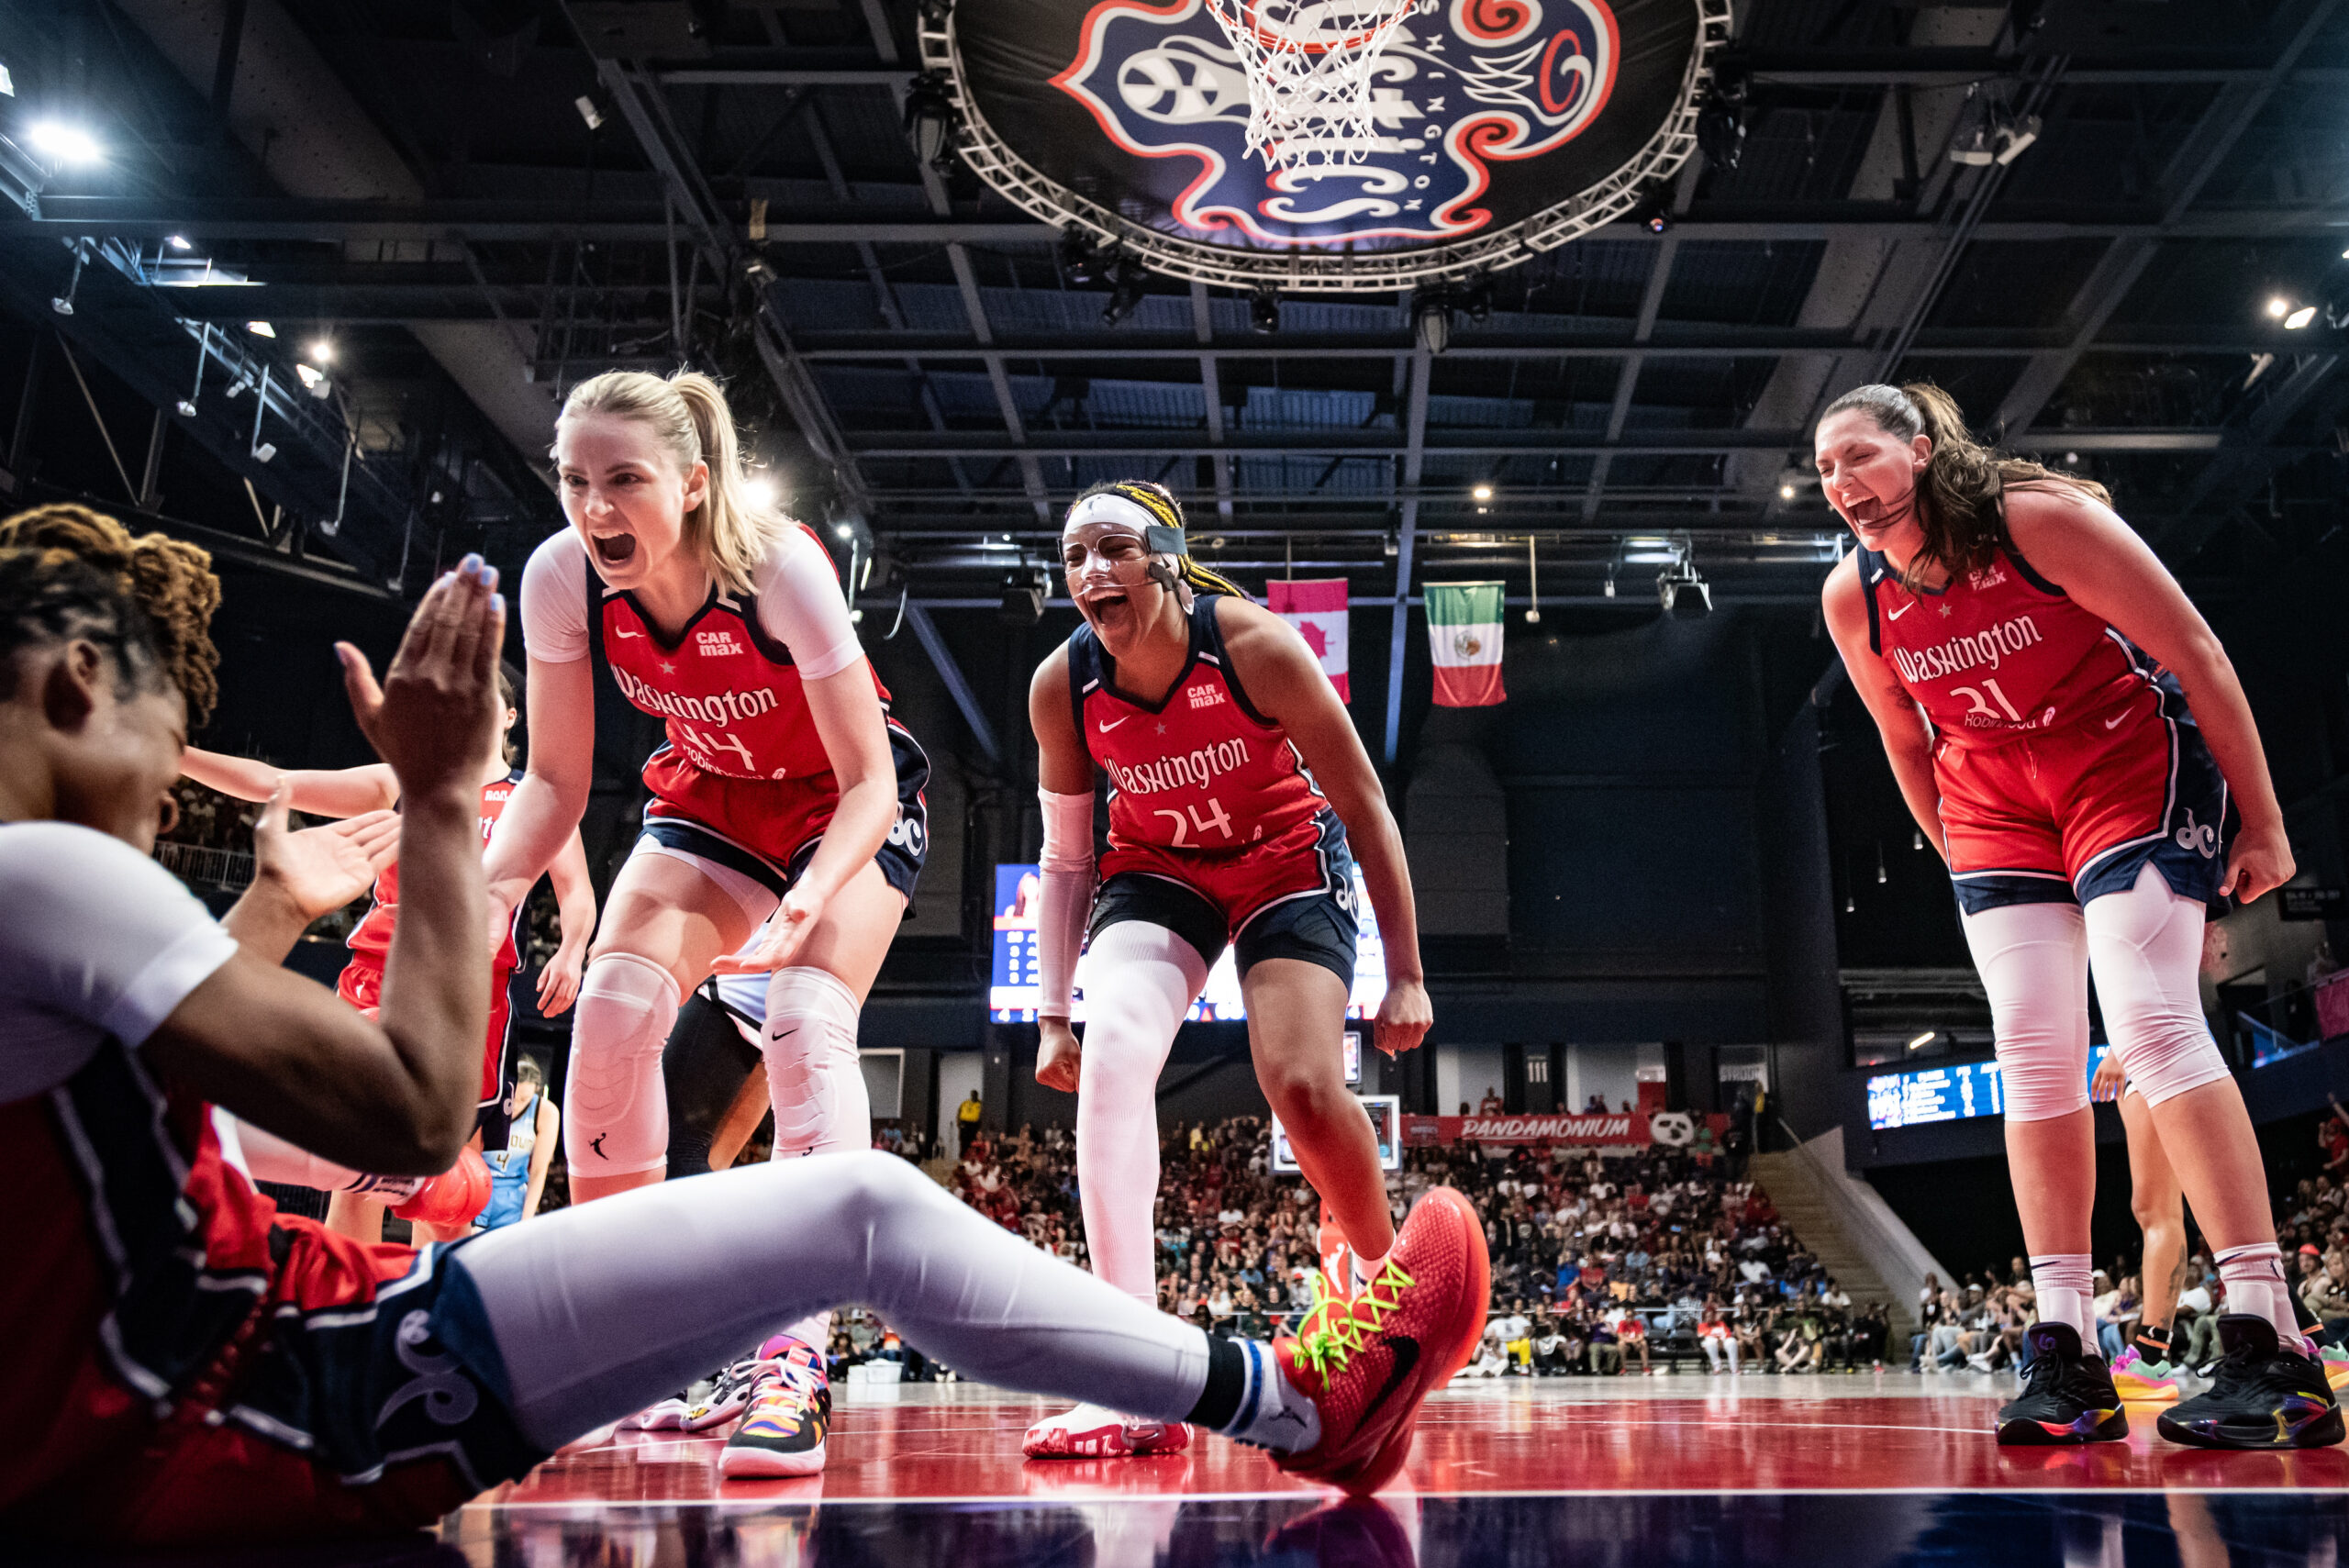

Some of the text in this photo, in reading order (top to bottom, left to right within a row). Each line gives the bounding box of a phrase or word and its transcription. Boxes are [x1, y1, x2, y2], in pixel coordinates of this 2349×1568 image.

[1403, 0, 1446, 211] SHINGTON
[696, 631, 731, 644] CAR
[699, 642, 744, 657] max
[1893, 615, 2043, 684] Washington
[610, 661, 779, 728] Washington
[1187, 684, 1217, 699] CAR
[1190, 692, 1226, 710] max
[1104, 737, 1251, 795] Washington
[1153, 797, 1234, 849] 24
[1461, 1118, 1631, 1138] PANDAMONIUM
